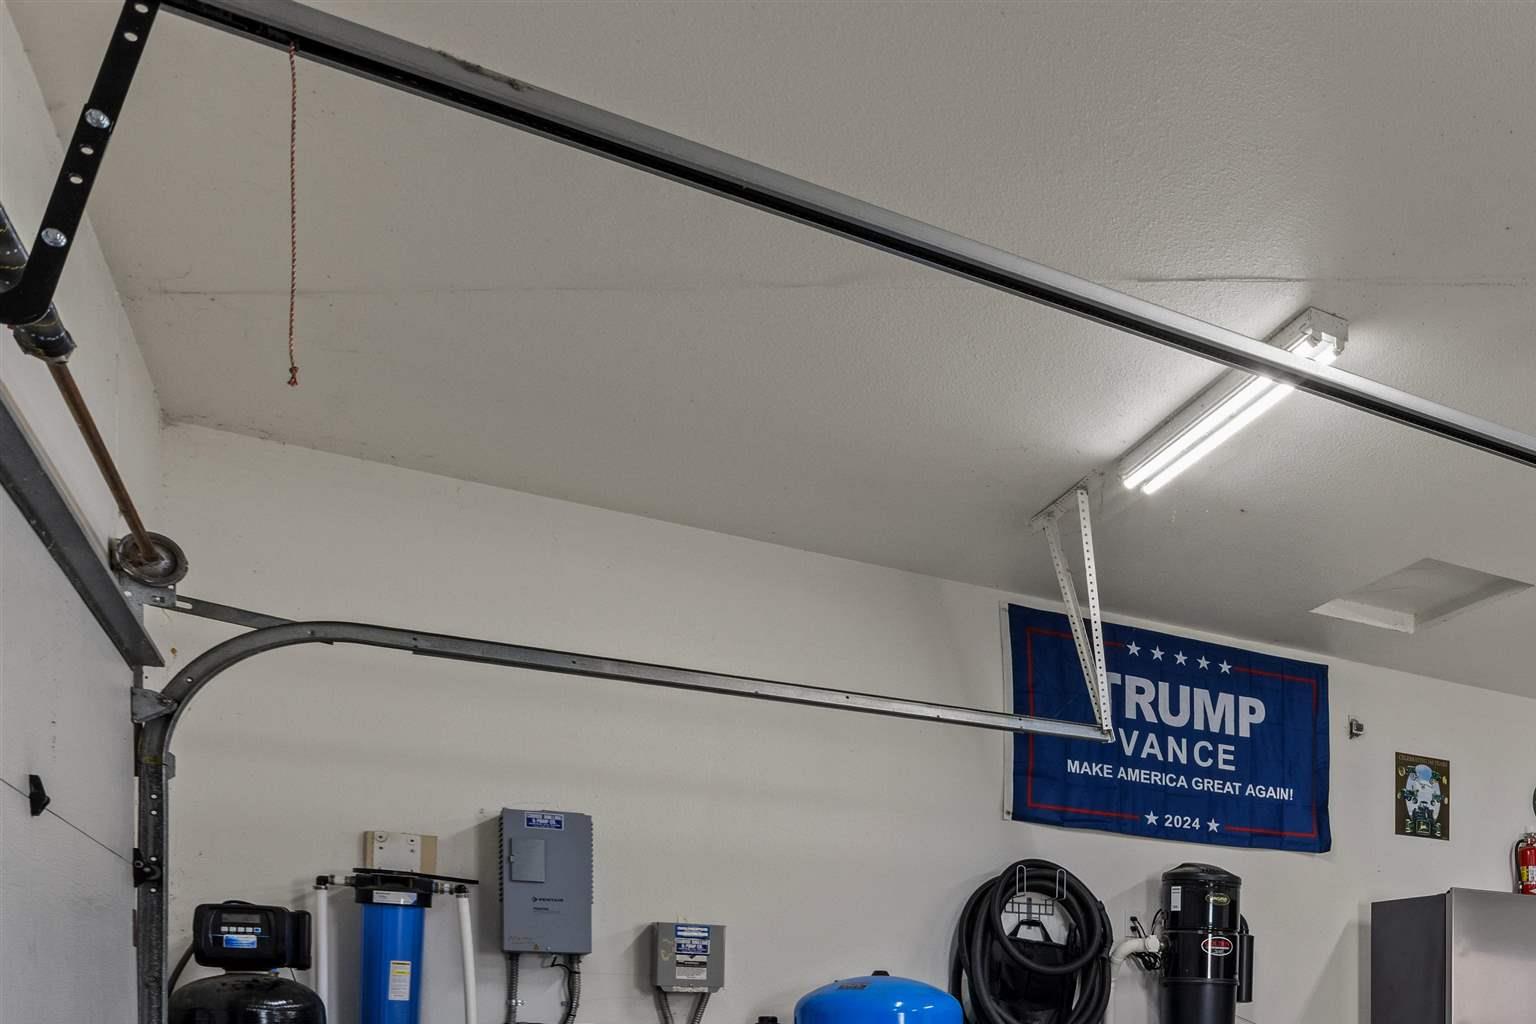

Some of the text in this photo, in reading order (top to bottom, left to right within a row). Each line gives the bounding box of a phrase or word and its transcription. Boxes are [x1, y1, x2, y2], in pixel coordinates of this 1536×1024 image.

[1118, 728, 1236, 771] VANCE
[1067, 759, 1294, 801] MAKE AMERICA GREAT AGAIN!
[1164, 813, 1201, 831] 2024
